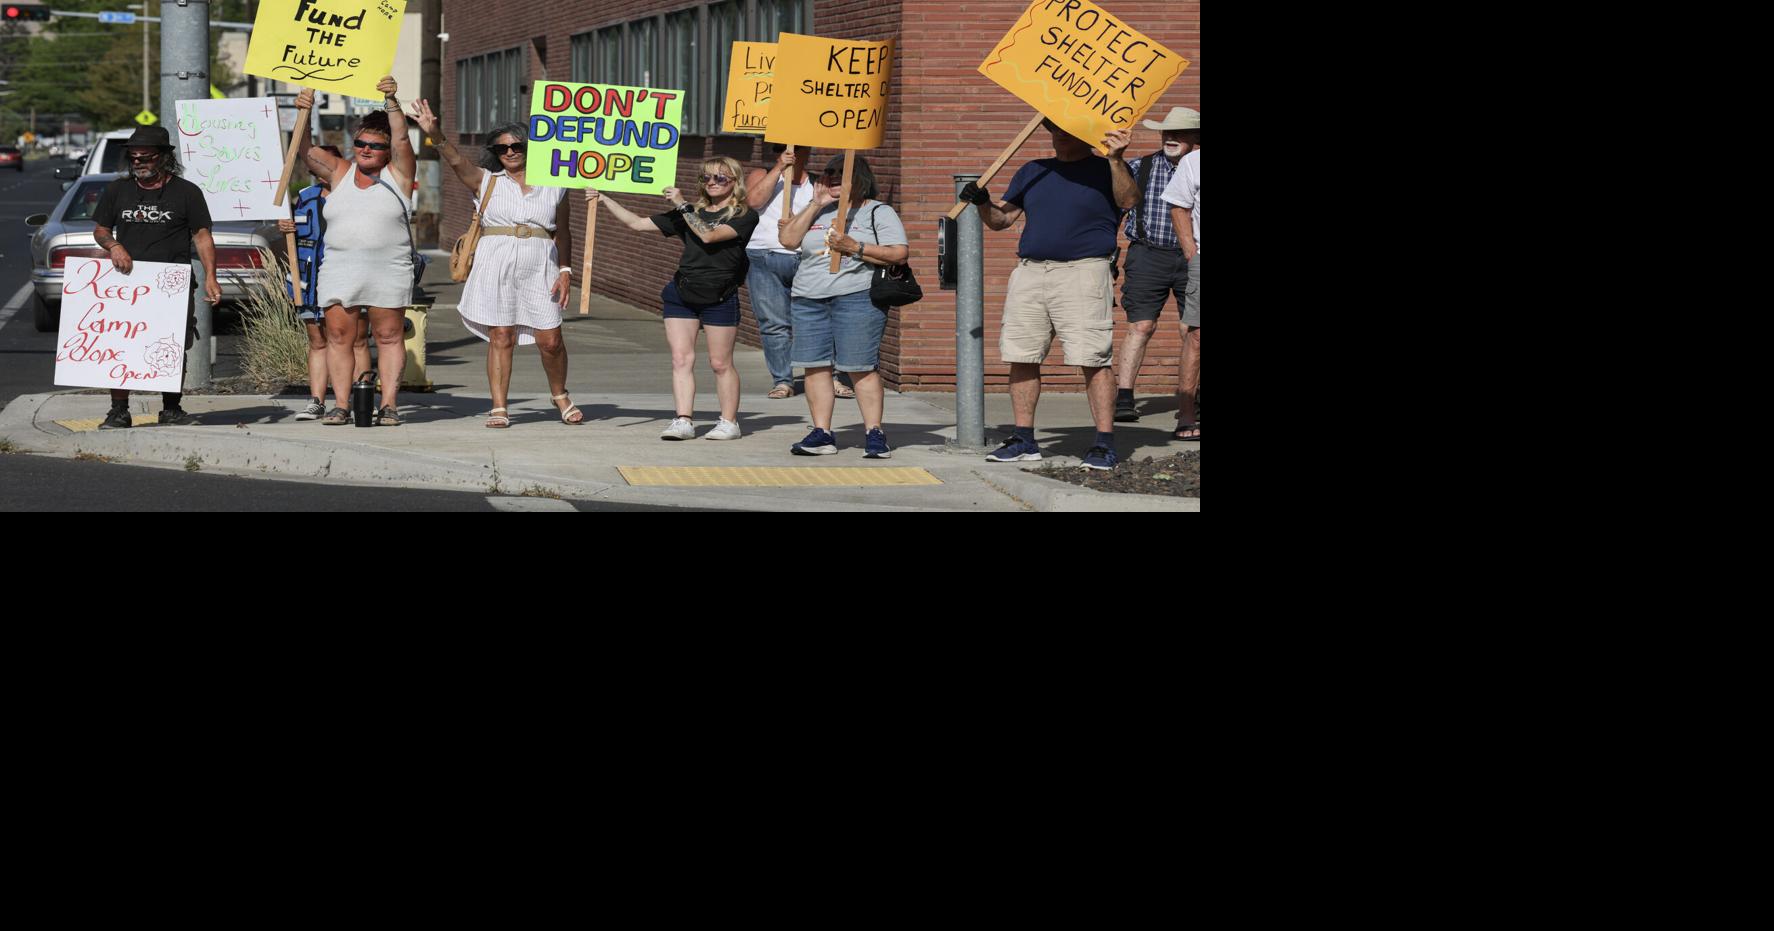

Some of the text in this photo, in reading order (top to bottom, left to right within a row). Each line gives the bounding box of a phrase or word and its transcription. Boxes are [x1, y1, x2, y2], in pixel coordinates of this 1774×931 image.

[306, 27, 346, 47] THE
[282, 44, 361, 67] Future
[746, 46, 775, 70] Liv
[827, 45, 889, 75] KEEP
[1040, 26, 1146, 101] SHELTER
[543, 84, 677, 120] DON'T
[800, 79, 871, 99] SHELTER
[1034, 54, 1134, 125] FUNDING
[528, 114, 679, 150] DEFUND
[819, 107, 882, 130] OPEN
[550, 149, 656, 184] HOPE
[121, 209, 174, 220] ROCK
[77, 301, 148, 339] Camp
